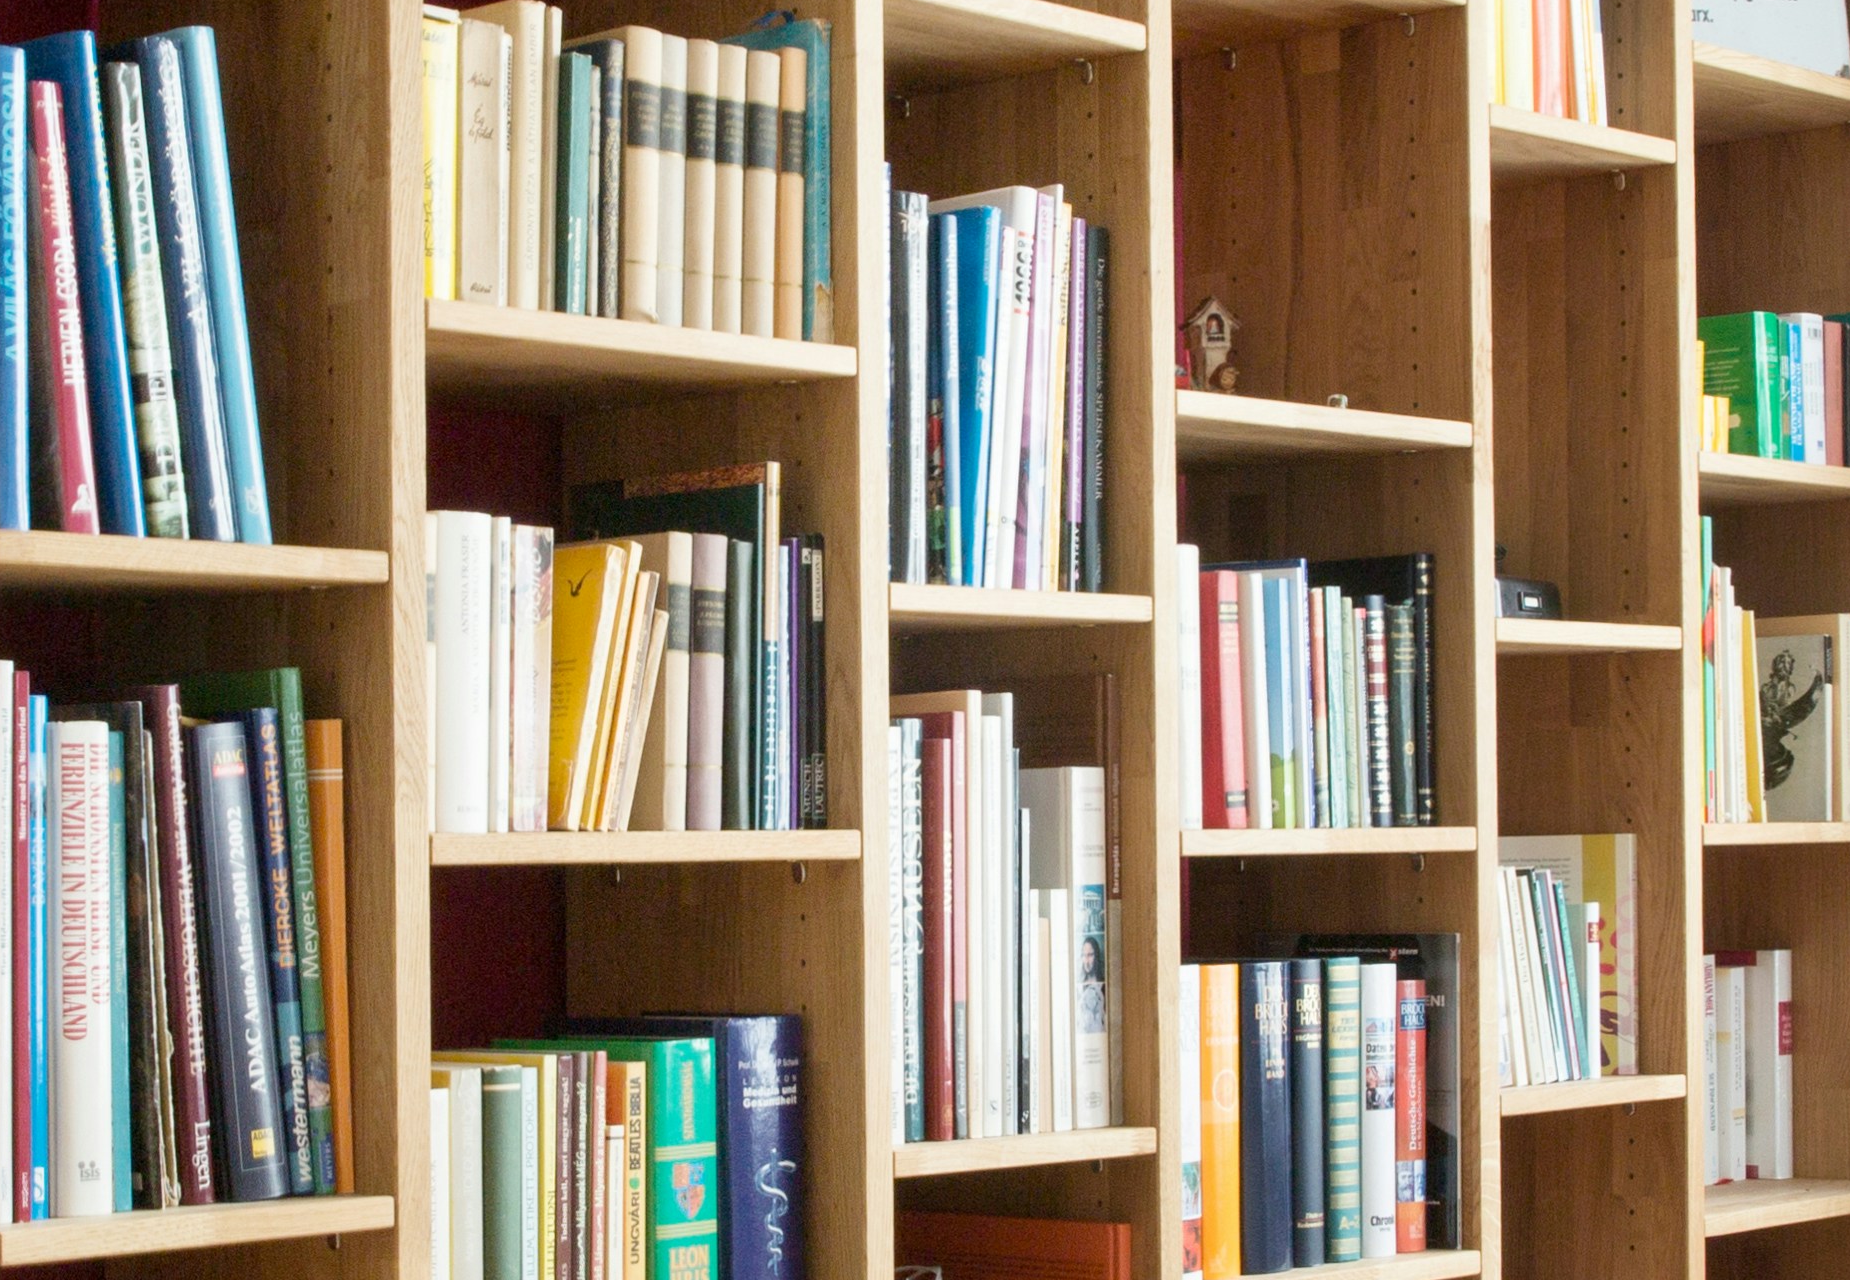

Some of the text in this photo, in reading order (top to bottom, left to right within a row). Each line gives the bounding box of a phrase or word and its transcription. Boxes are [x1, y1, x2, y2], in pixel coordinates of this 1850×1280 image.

[260, 723, 287, 856] WELTATLAS
[288, 711, 322, 979] Meyers Universalatlas
[227, 805, 257, 920] 2001/2002
[194, 1120, 210, 1190] Lingen
[286, 1033, 313, 1183] westermann
[629, 1076, 642, 1171] BEATLES BIBLIA
[668, 1243, 710, 1268] LEON
